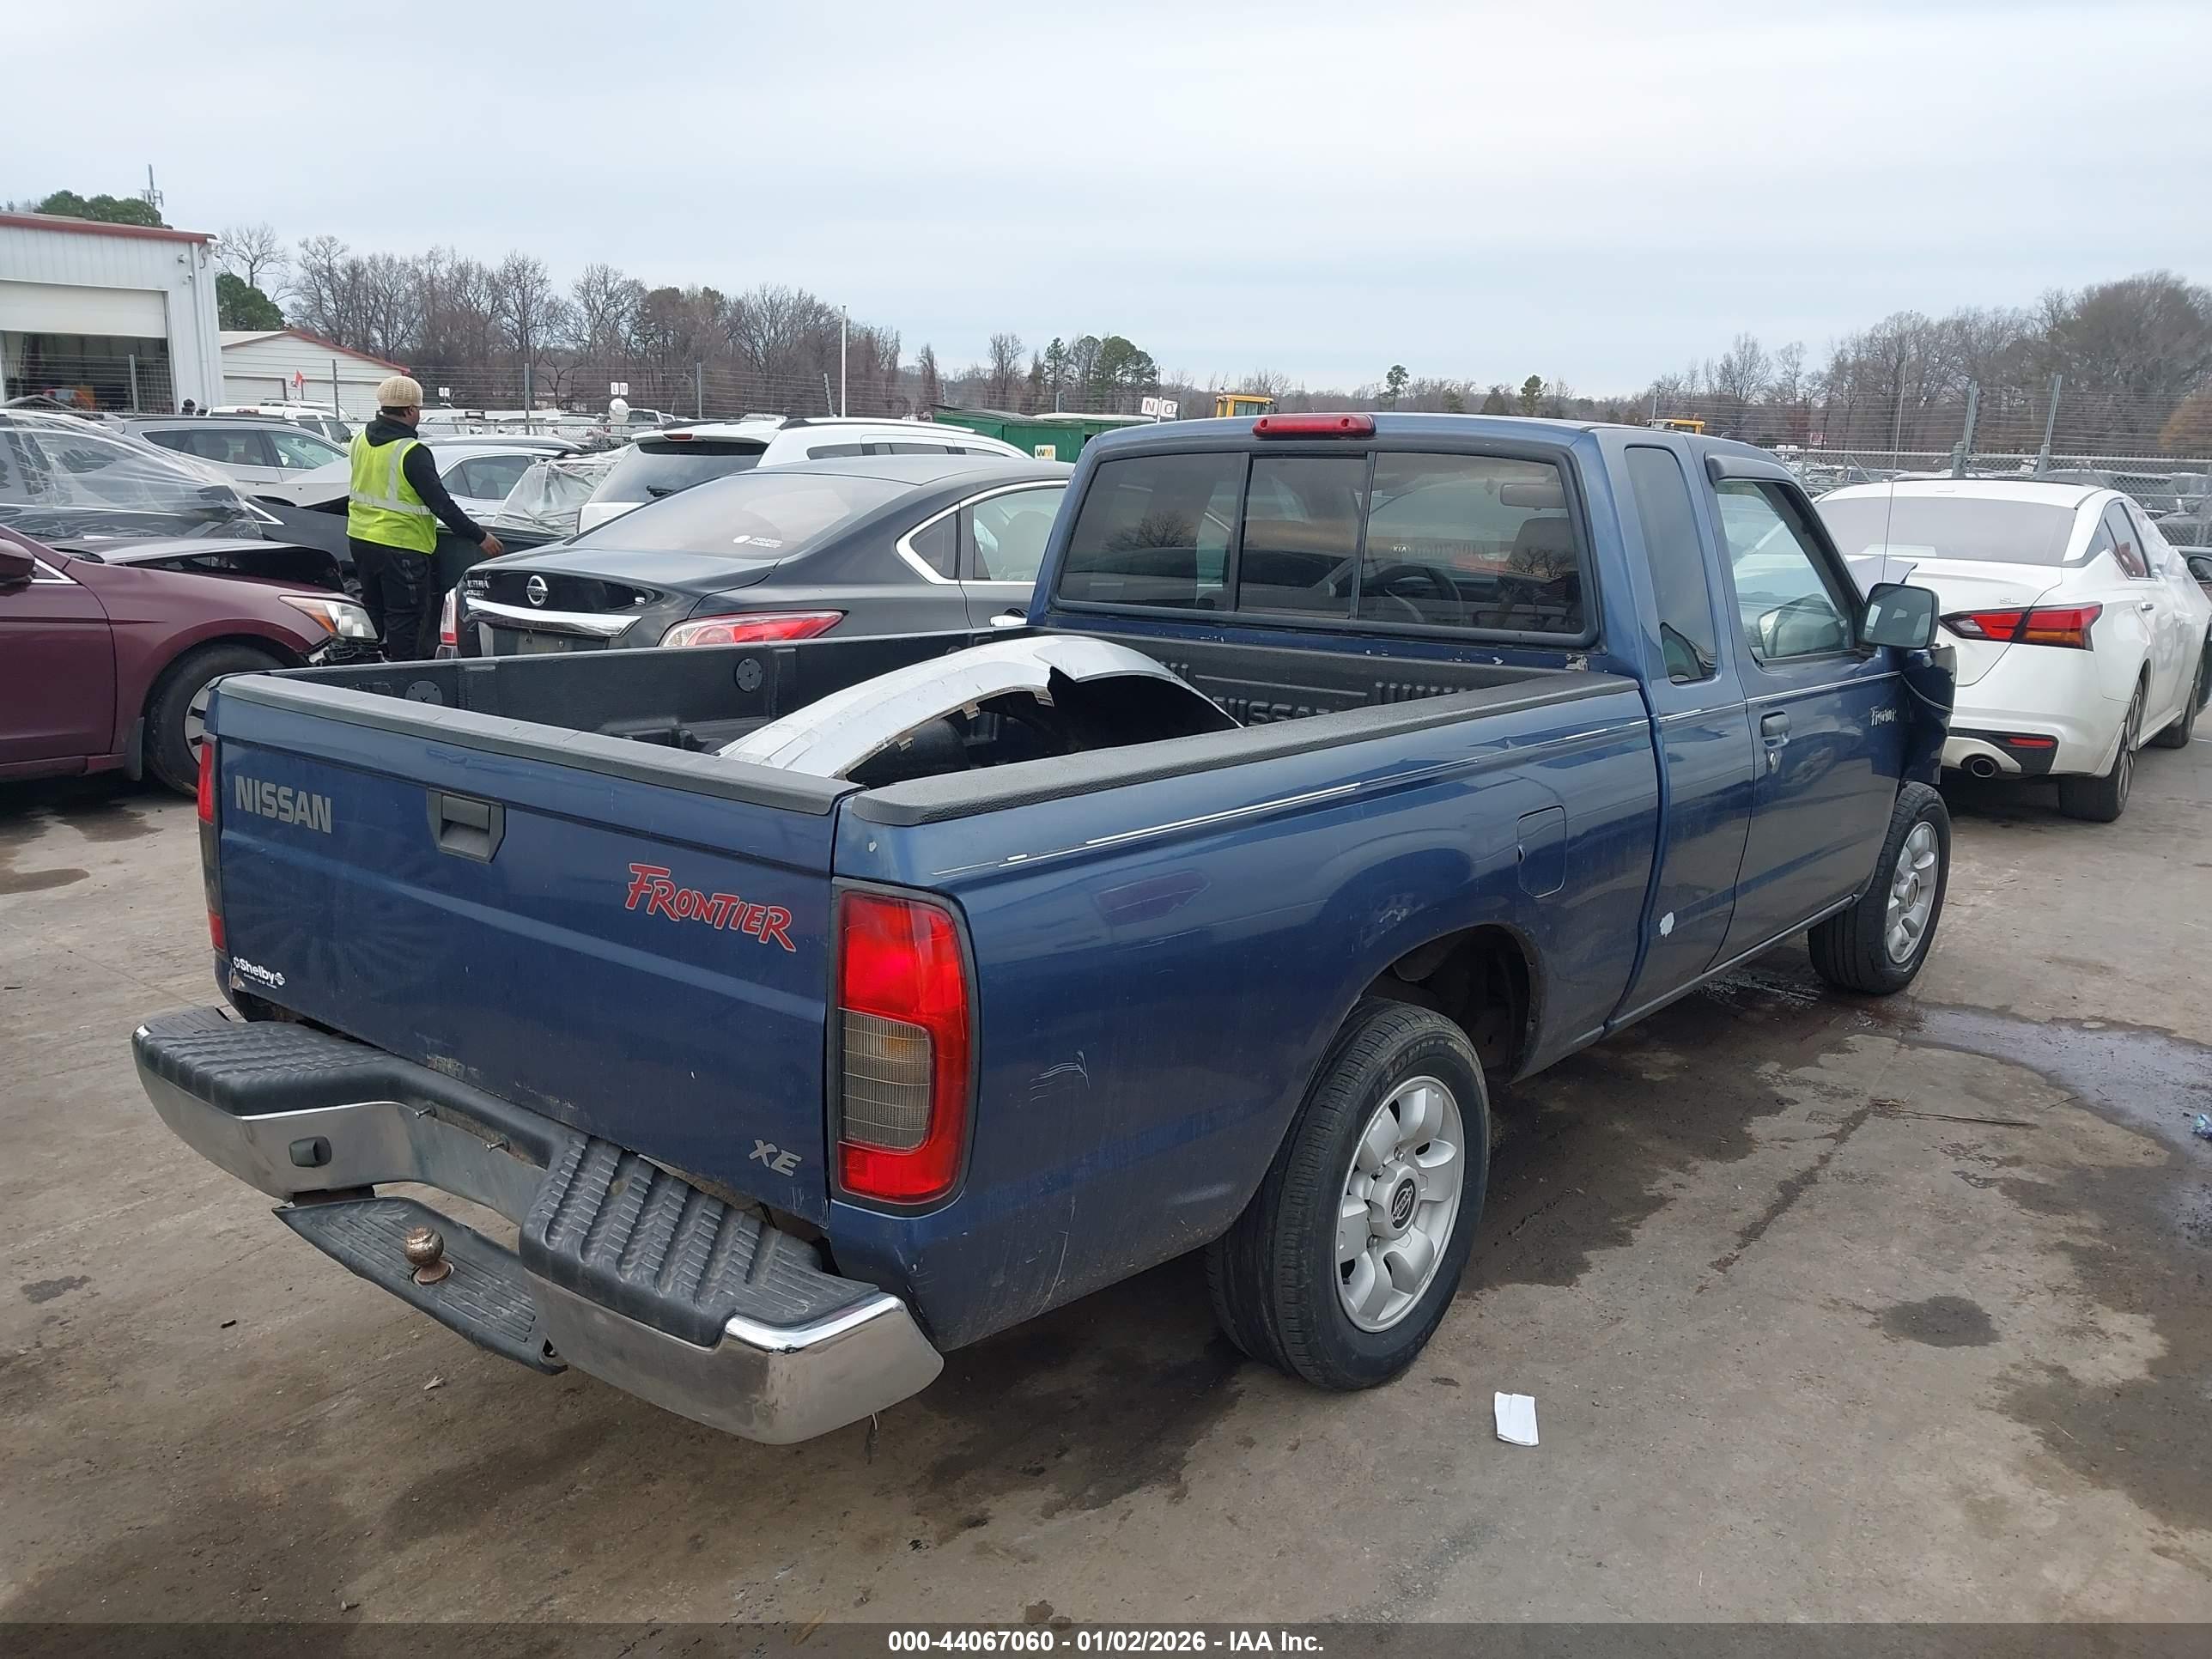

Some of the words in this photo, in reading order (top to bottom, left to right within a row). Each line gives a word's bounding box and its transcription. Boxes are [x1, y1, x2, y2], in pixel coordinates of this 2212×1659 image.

[1146, 401, 1155, 412] N
[635, 597, 646, 605] S
[235, 775, 331, 835] NISSAN
[240, 957, 274, 984] Shelby
[749, 1139, 802, 1177] XE
